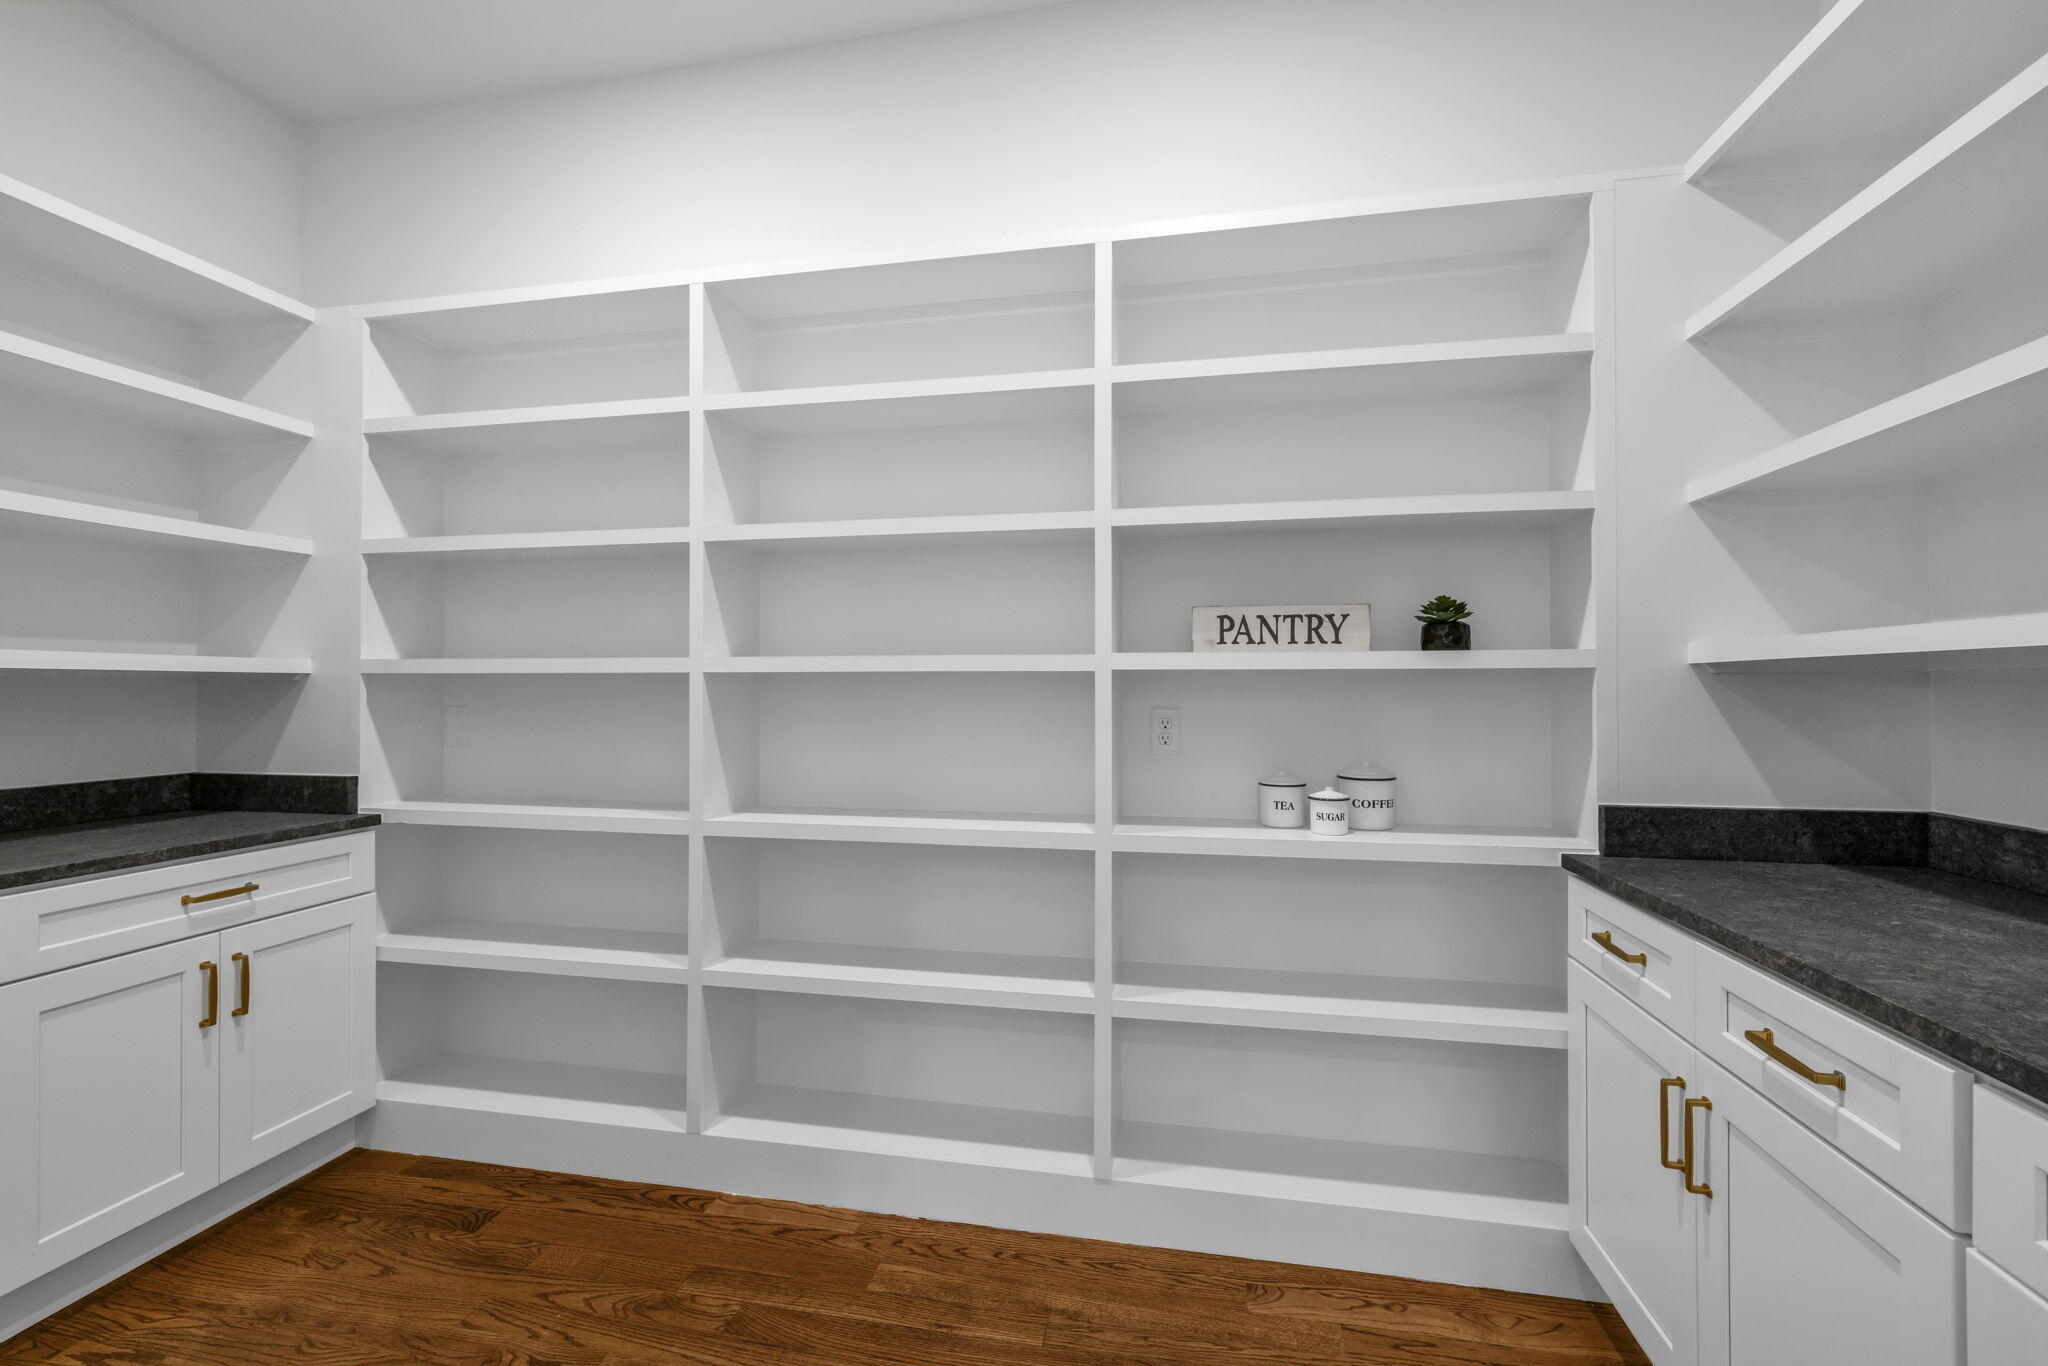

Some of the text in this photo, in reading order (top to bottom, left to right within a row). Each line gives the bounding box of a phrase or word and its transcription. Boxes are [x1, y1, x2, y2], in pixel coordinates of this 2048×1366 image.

[1216, 613, 1350, 645] PANTRY
[1273, 800, 1295, 811] TEA
[1315, 812, 1346, 822] SUGAR
